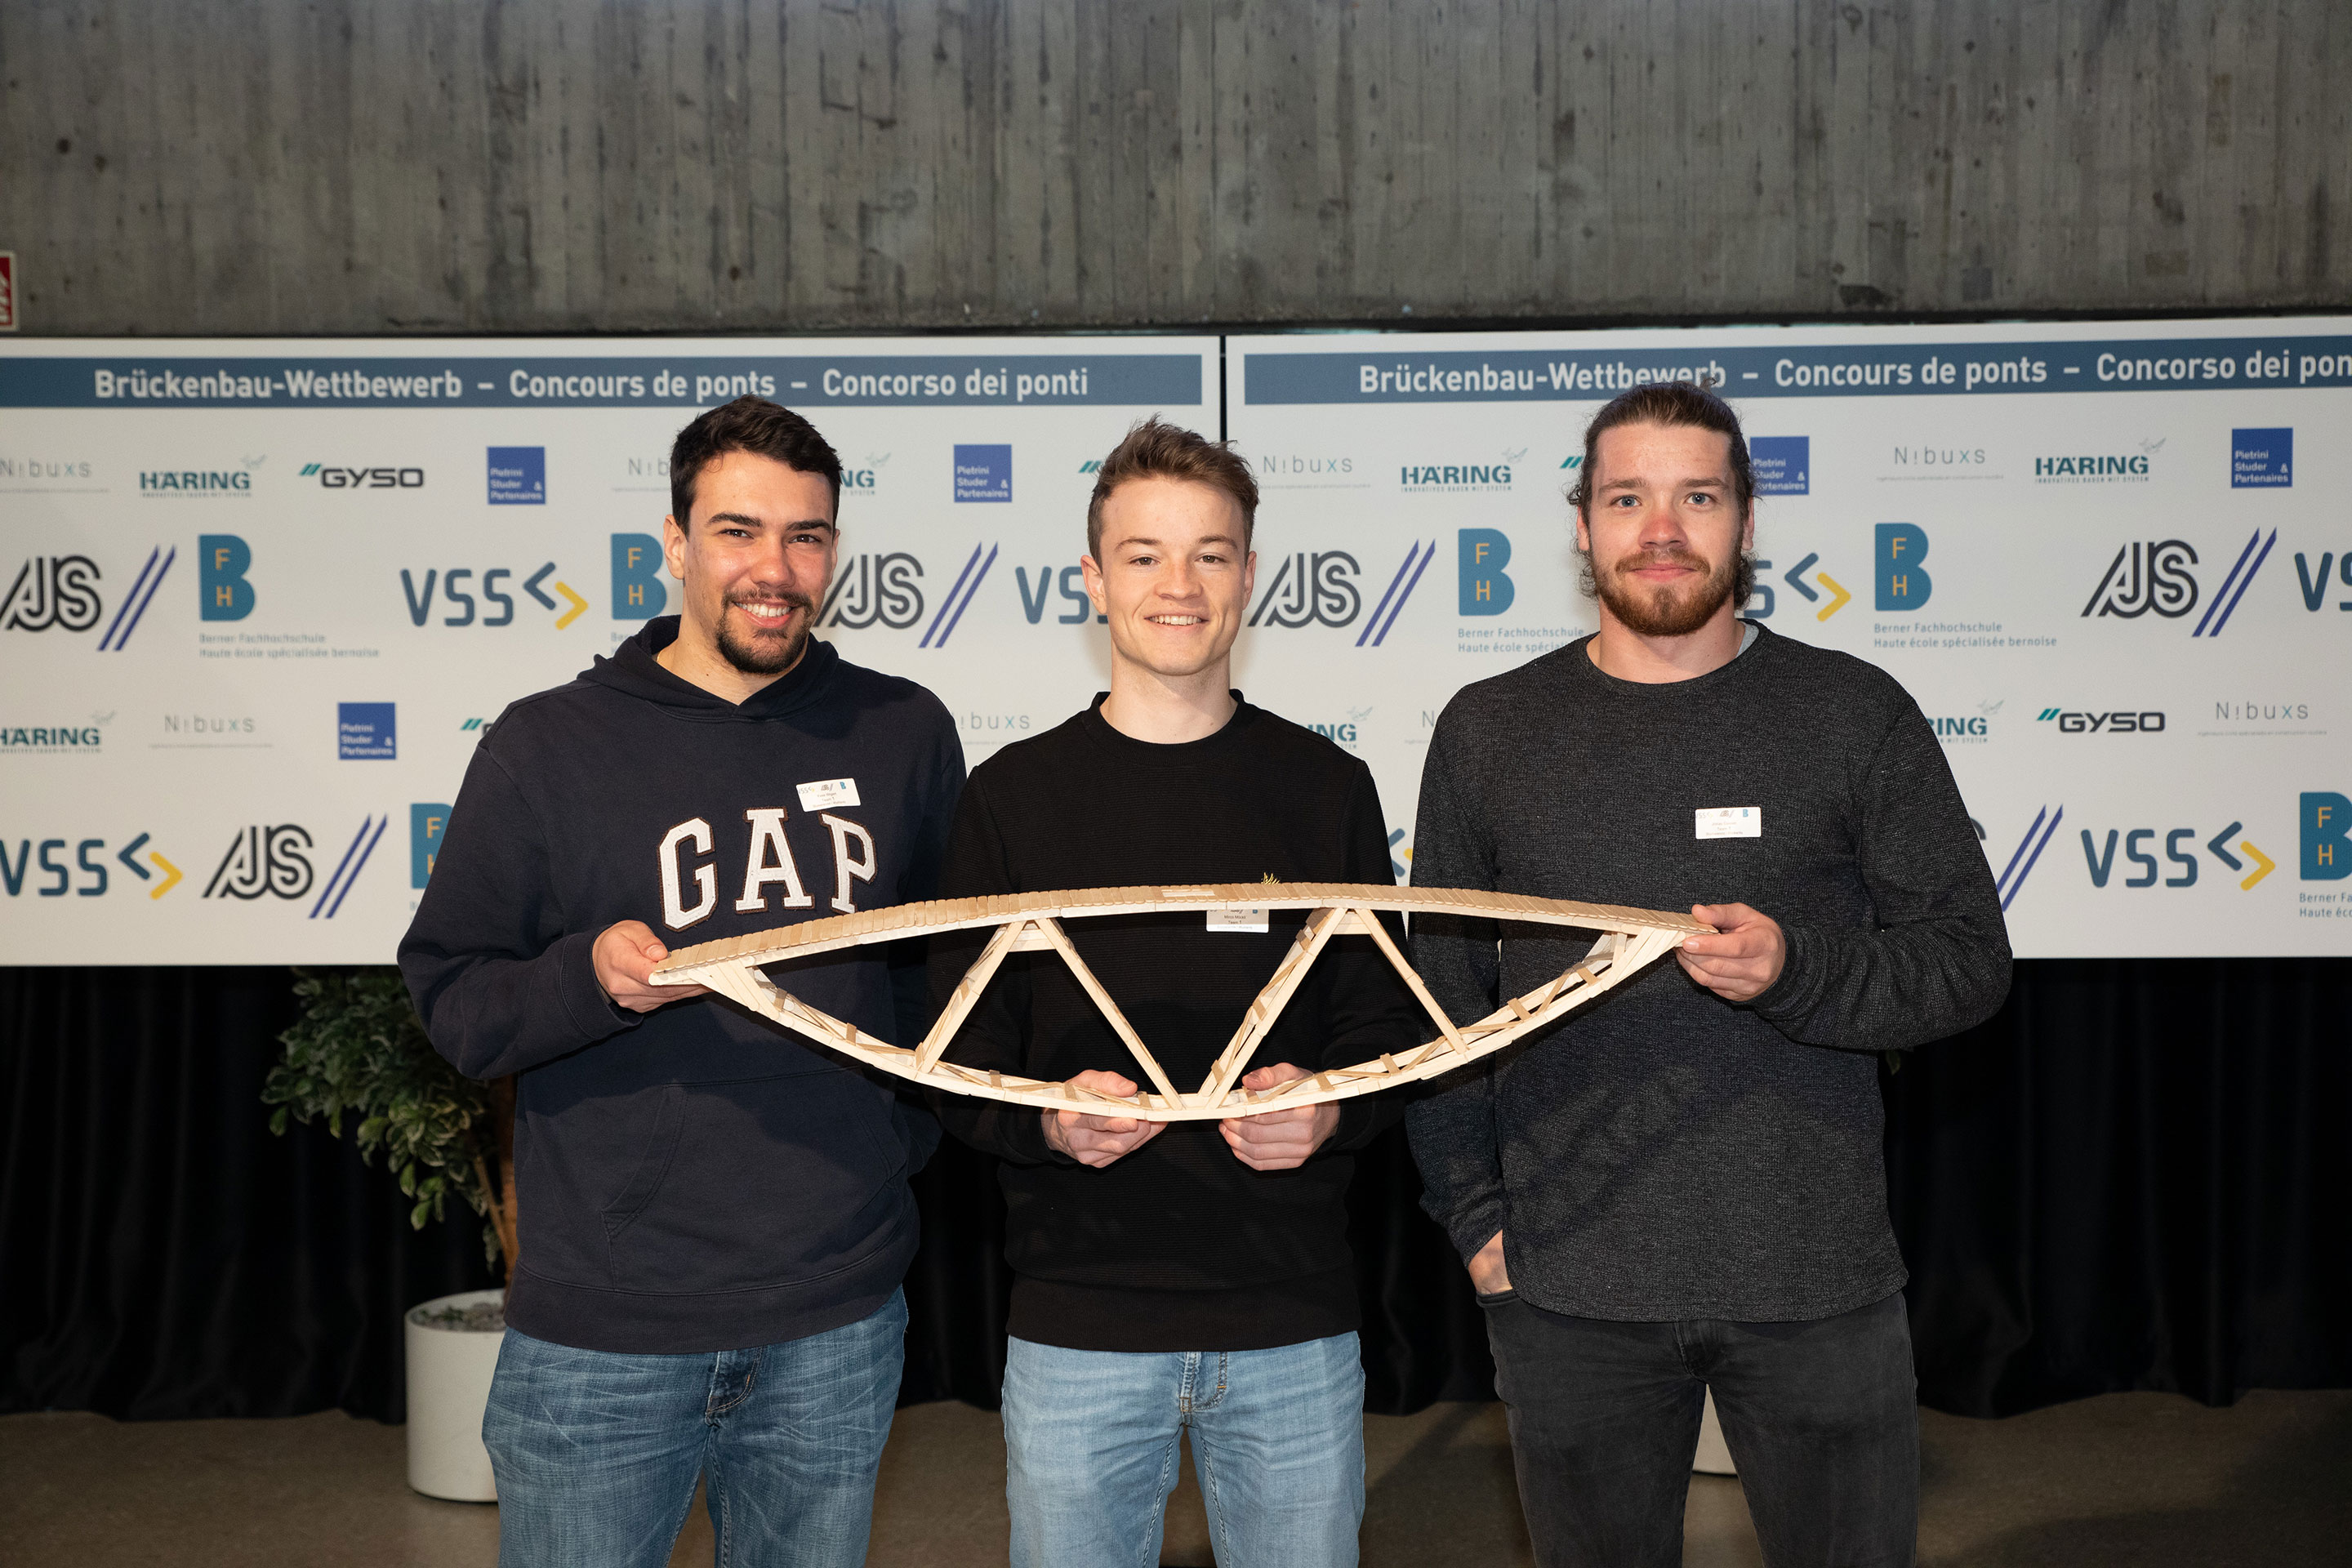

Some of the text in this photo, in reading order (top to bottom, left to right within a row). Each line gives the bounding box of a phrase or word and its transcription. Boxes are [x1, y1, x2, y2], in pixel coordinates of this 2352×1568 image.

[1360, 360, 1726, 393] Brückenbau-Wettbewerb
[1775, 359, 1913, 386] Concours
[1921, 357, 1957, 385] de
[1965, 357, 2047, 390] ponts
[2096, 353, 2236, 381] Concorso
[2245, 350, 2290, 378] dei
[2300, 354, 2352, 384] pon
[95, 370, 463, 398] Brückenbau-Wettbewerb
[510, 370, 645, 398] Concours
[653, 370, 688, 398] de
[697, 371, 776, 403] ponts
[822, 369, 956, 396] Concorso
[964, 368, 1007, 396] dei
[1017, 368, 1088, 402] ponti
[2235, 449, 2269, 459] Pietrini
[957, 466, 989, 474] Pietrini
[2036, 456, 2149, 475] HÄRING
[2235, 461, 2267, 471] Studer
[321, 468, 424, 488] GYSO
[1401, 466, 1511, 484] HÄRING
[2235, 473, 2288, 483] Partenaires
[957, 477, 987, 487] Studer
[957, 488, 1008, 497] Partenaires
[400, 569, 514, 626] VSS
[1015, 566, 1109, 625] VS
[1458, 627, 1584, 638] Berner Fachhochschule
[1874, 622, 2002, 633] Berner Fachhochschule
[1458, 644, 1490, 653] Haute
[1493, 643, 1523, 653] école
[1874, 636, 2057, 648] Haute école spécialisée bernoise
[2059, 712, 2166, 733] GYSO
[2081, 829, 2198, 888] VSS
[0, 840, 108, 897] VSS
[657, 807, 878, 931] GAP
[2300, 893, 2336, 903] Berner
[2300, 907, 2332, 918] Haute
